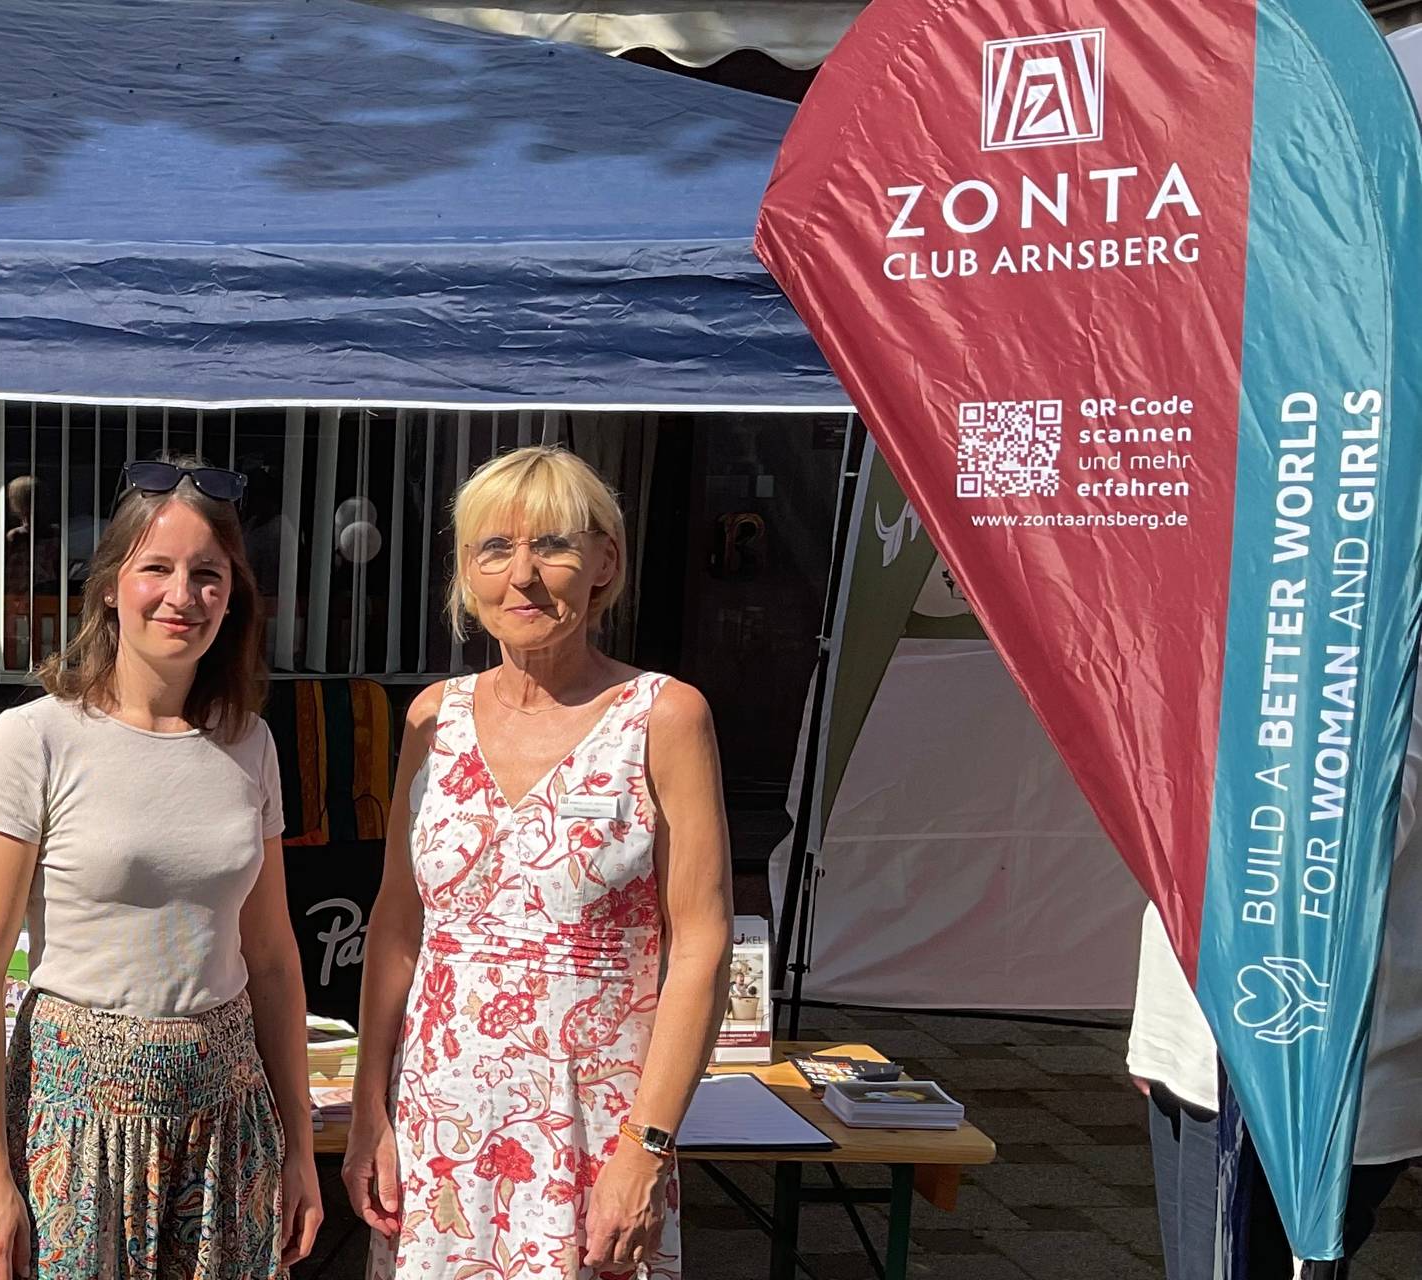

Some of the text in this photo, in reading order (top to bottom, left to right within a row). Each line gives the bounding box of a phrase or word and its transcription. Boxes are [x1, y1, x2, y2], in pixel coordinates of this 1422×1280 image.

[884, 162, 1202, 239] ZONTA
[882, 232, 1200, 281] CLUB ARNSBERG
[1079, 395, 1195, 419] QR-Code
[1078, 423, 1193, 445] scannen
[1078, 450, 1192, 471] und mehr
[1076, 478, 1190, 499] erfahren
[970, 511, 1189, 529] www.zontaarnsberg.de
[1242, 391, 1319, 926] BUILD A BETTER WORLD
[1299, 388, 1382, 920] FOR WOMAN AND GIRLS
